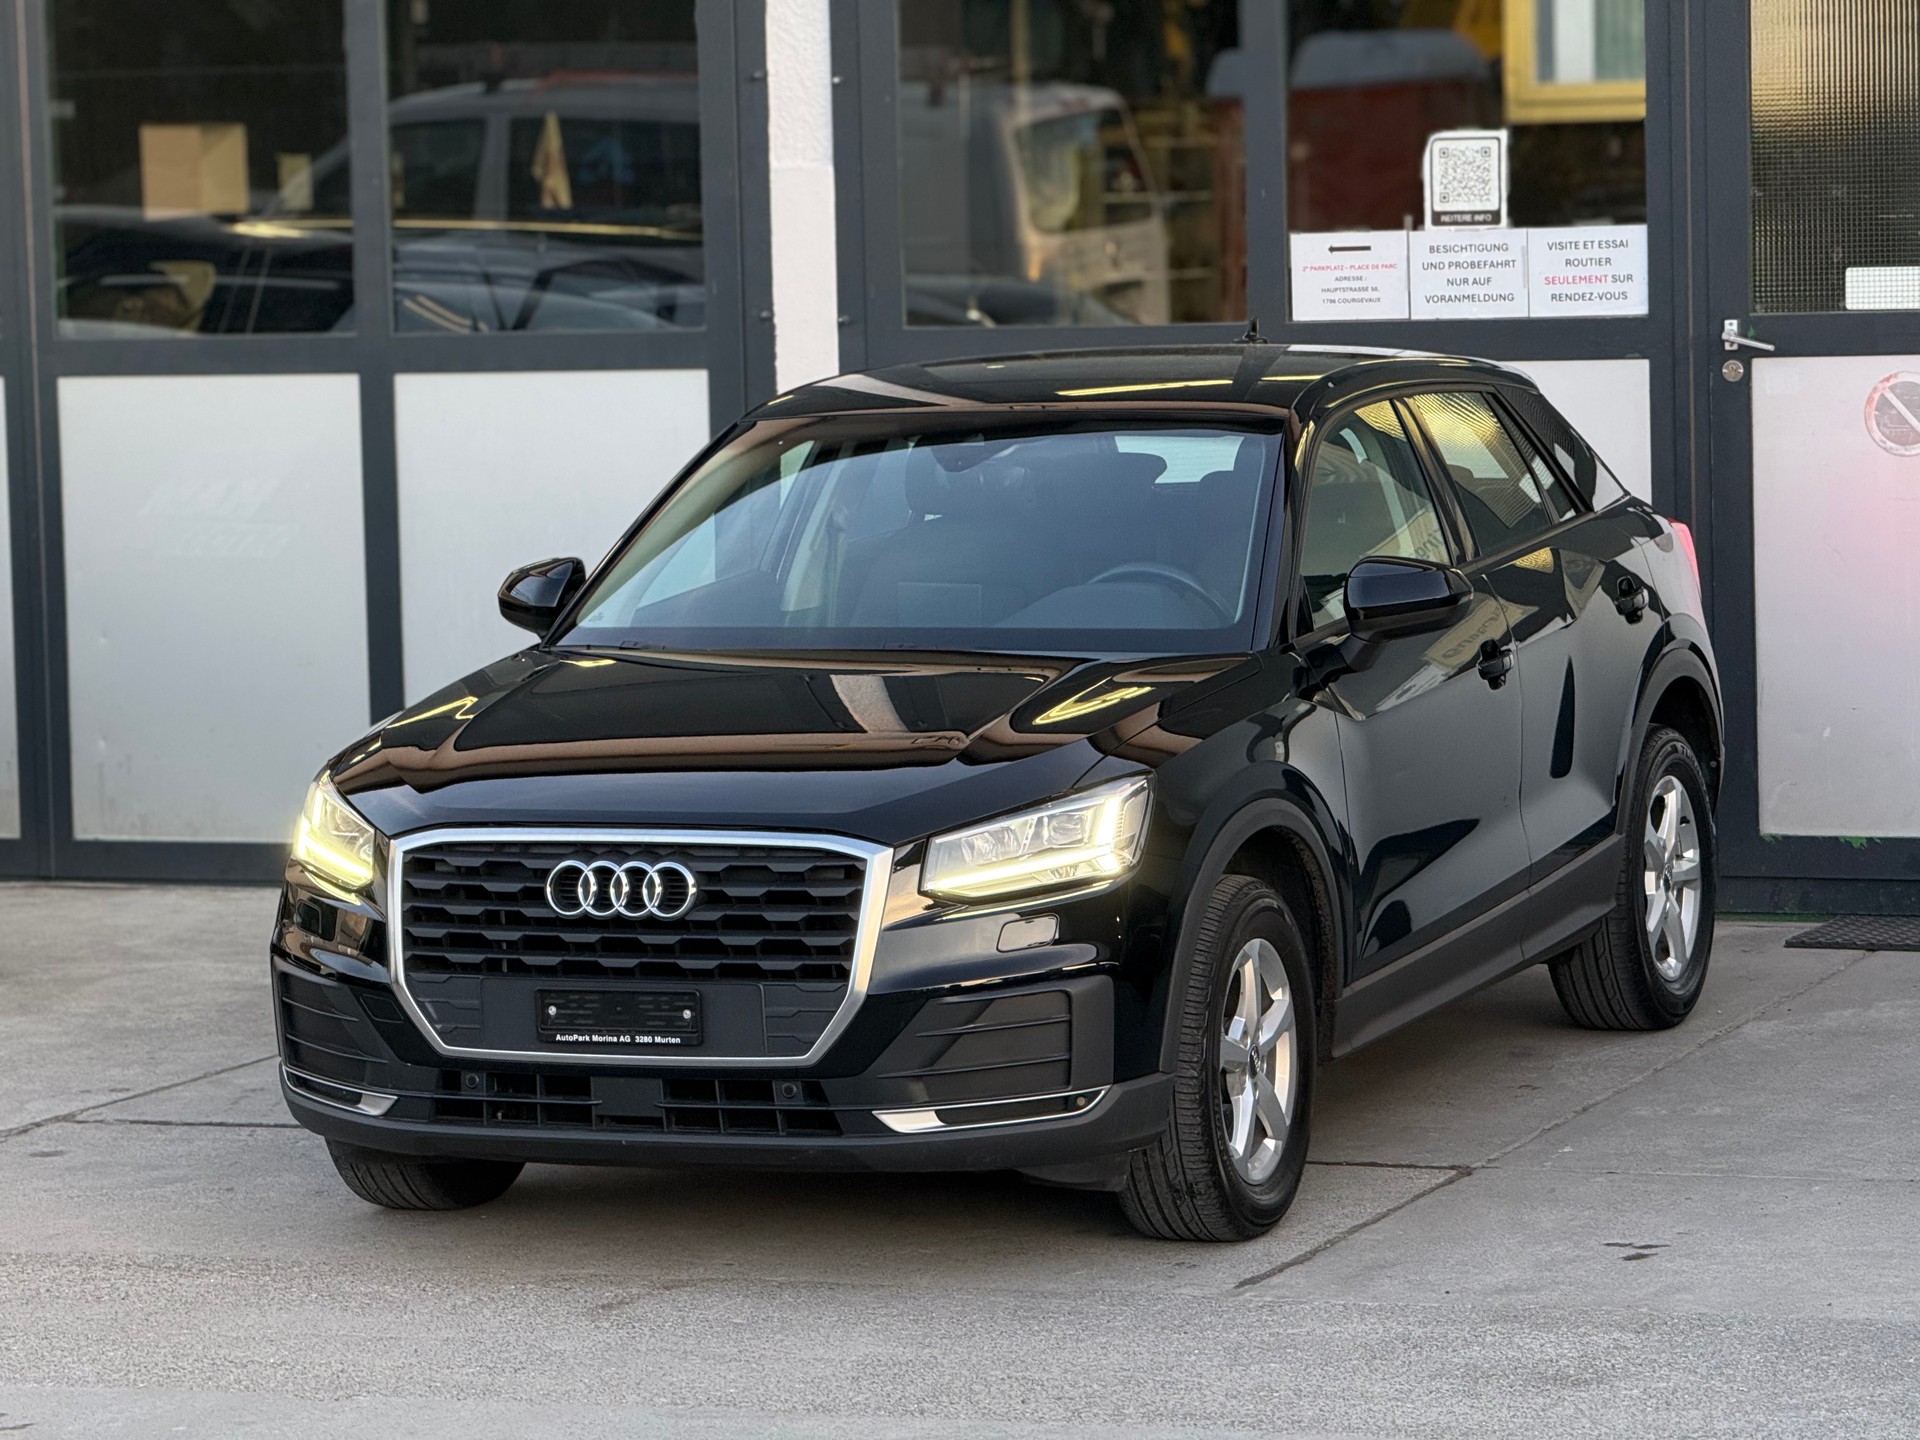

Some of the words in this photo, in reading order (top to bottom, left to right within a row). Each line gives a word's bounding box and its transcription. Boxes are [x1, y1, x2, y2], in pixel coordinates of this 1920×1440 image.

[1474, 212, 1492, 222] INFO
[1429, 243, 1509, 254] BESICHTIGUNG
[1547, 241, 1580, 251] VISITE
[1583, 240, 1596, 250] ET
[1598, 239, 1629, 249] ESSAI
[1422, 261, 1445, 271] UND
[1448, 259, 1517, 270] PROBEFAHRT
[1565, 257, 1612, 267] ROUTIER
[1446, 277, 1470, 287] NUR
[1471, 276, 1492, 286] AUF
[1544, 274, 1609, 286] SEULEMENT
[1611, 273, 1634, 283] SUR
[1425, 292, 1515, 304] VORANMELDUNG
[1551, 291, 1628, 302] RENDEZ-VOUS
[556, 1033, 591, 1042] AutoPark
[592, 1034, 617, 1043] Morina
[619, 1035, 631, 1043] AG
[635, 1035, 653, 1043] 3280
[654, 1036, 681, 1044] Murten
